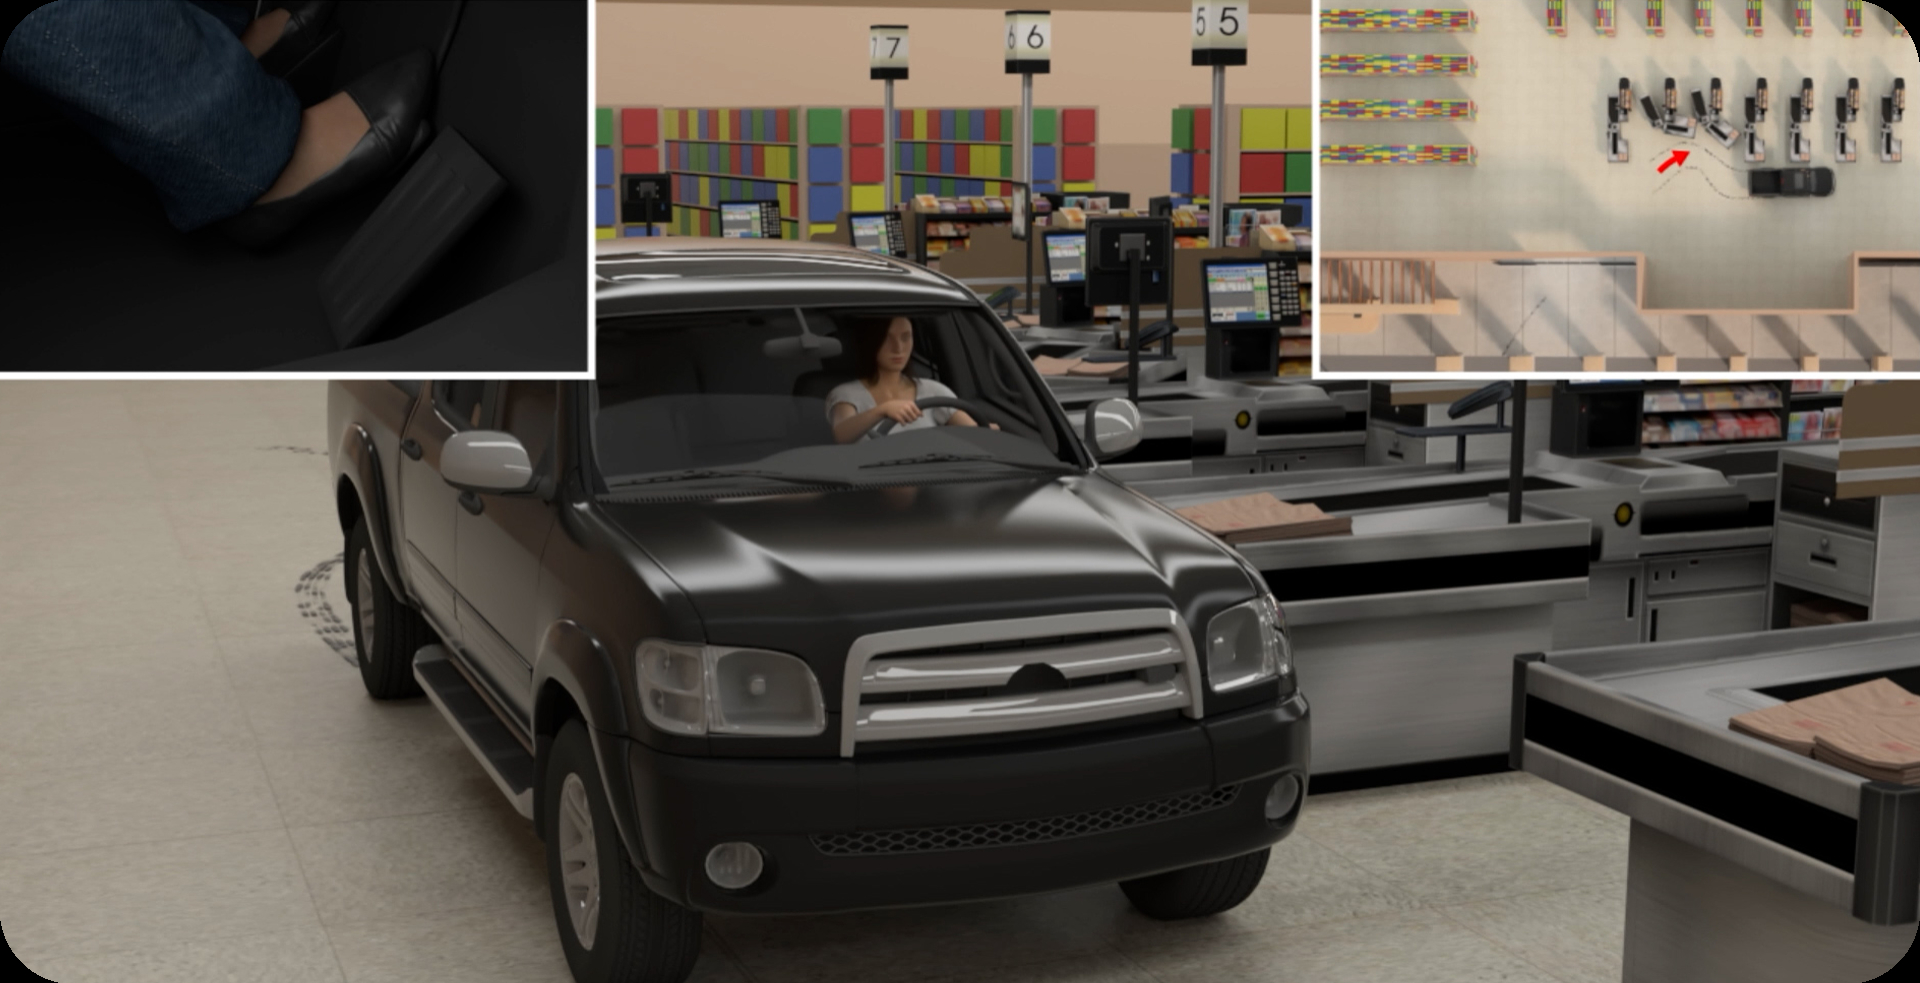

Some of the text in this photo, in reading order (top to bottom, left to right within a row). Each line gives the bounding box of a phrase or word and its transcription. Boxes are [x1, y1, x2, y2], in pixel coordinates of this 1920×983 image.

[1196, 6, 1206, 37] 5
[1219, 7, 1240, 37] 5
[886, 37, 901, 59] 7
[1008, 24, 1016, 50] 6
[1027, 24, 1044, 50] 6
